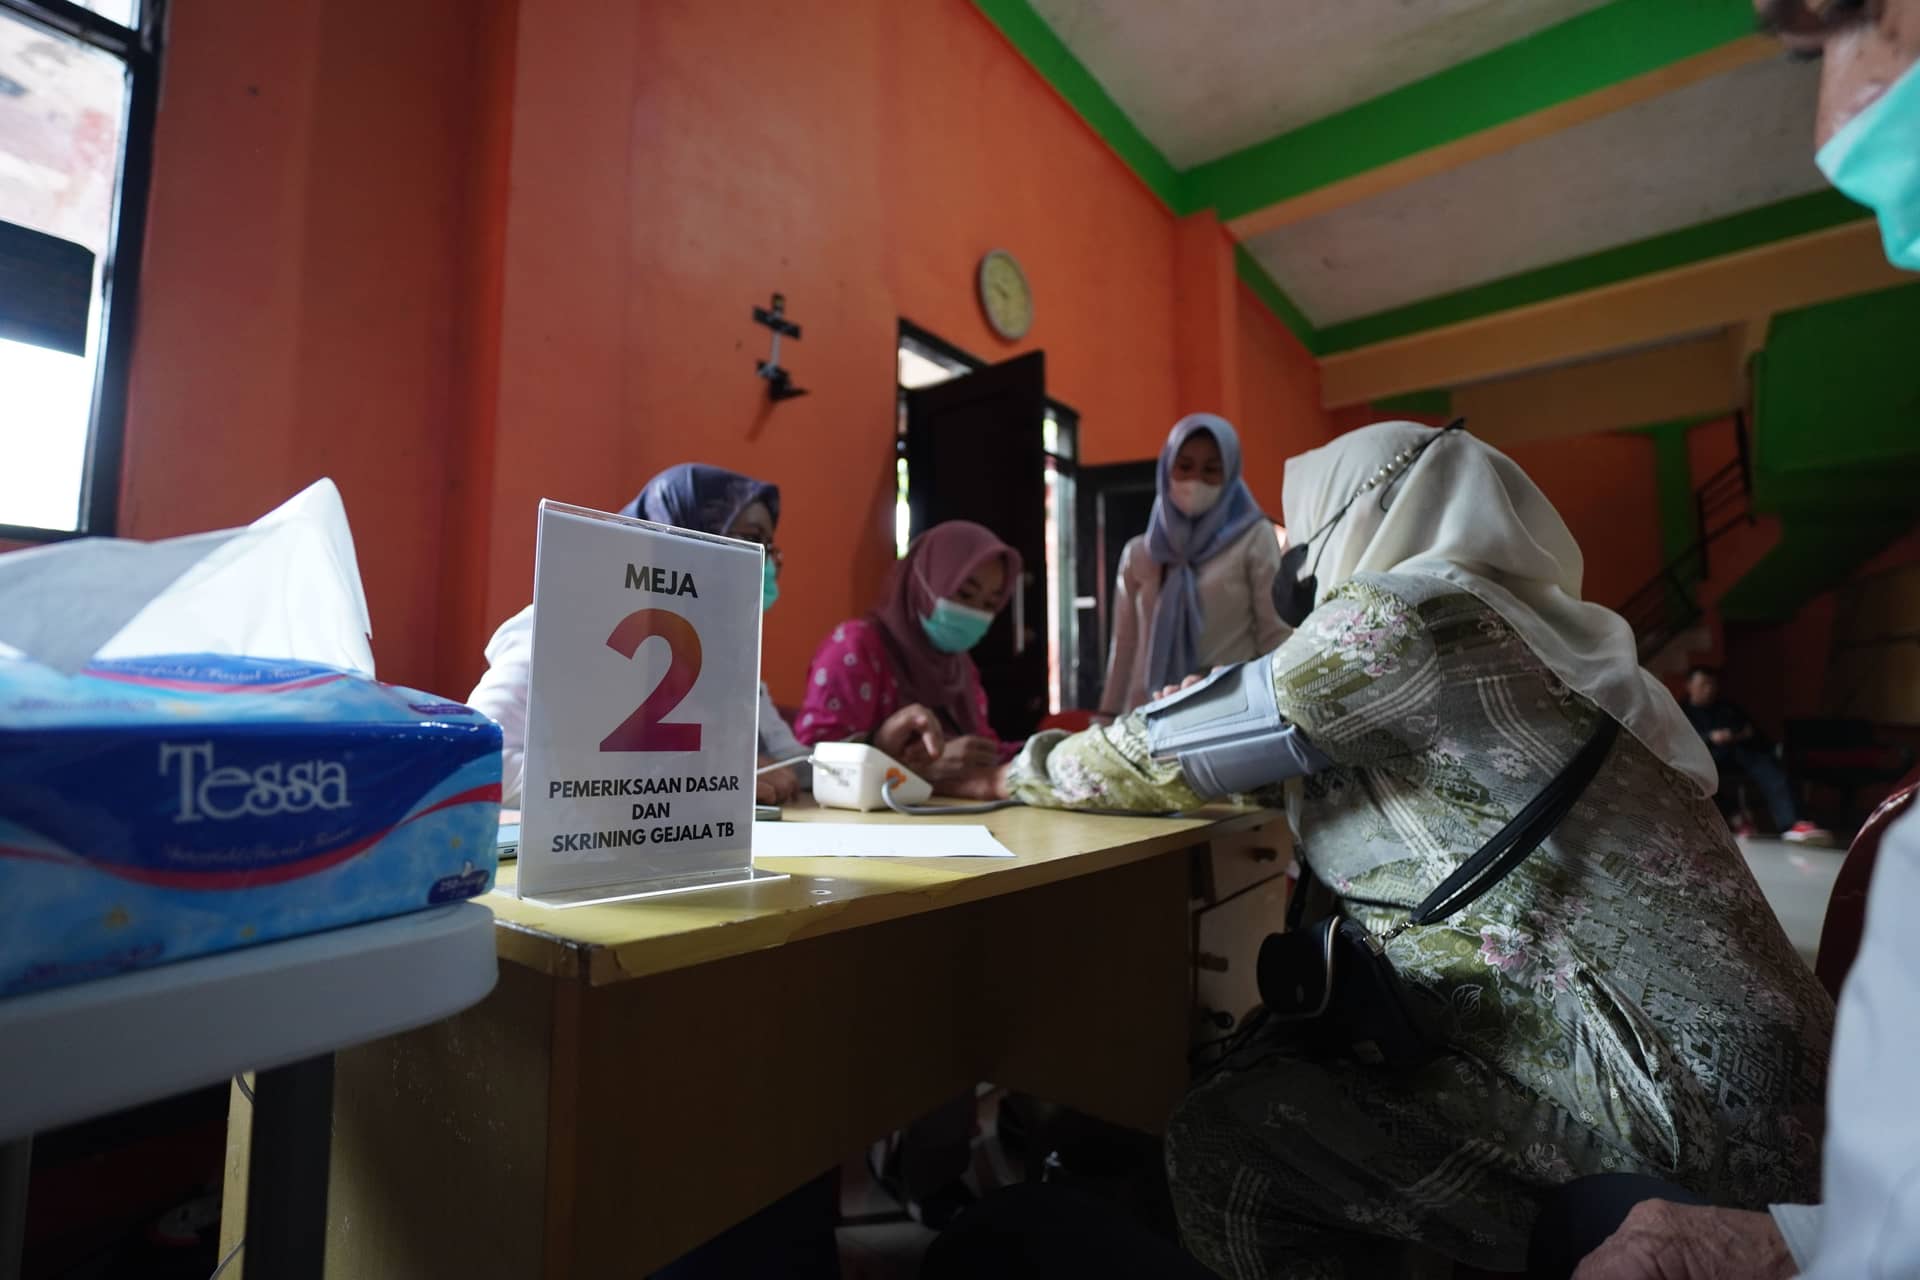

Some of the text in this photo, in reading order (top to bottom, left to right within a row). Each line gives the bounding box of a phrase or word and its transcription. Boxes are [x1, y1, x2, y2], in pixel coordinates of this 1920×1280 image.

[624, 563, 698, 598] MEJA
[599, 608, 703, 752] 2
[158, 742, 352, 824] Tessa
[549, 775, 740, 799] PEMERIKSAAN DASAR
[631, 802, 671, 821] DAN
[551, 821, 735, 853] SKRINING GEJALA TB
